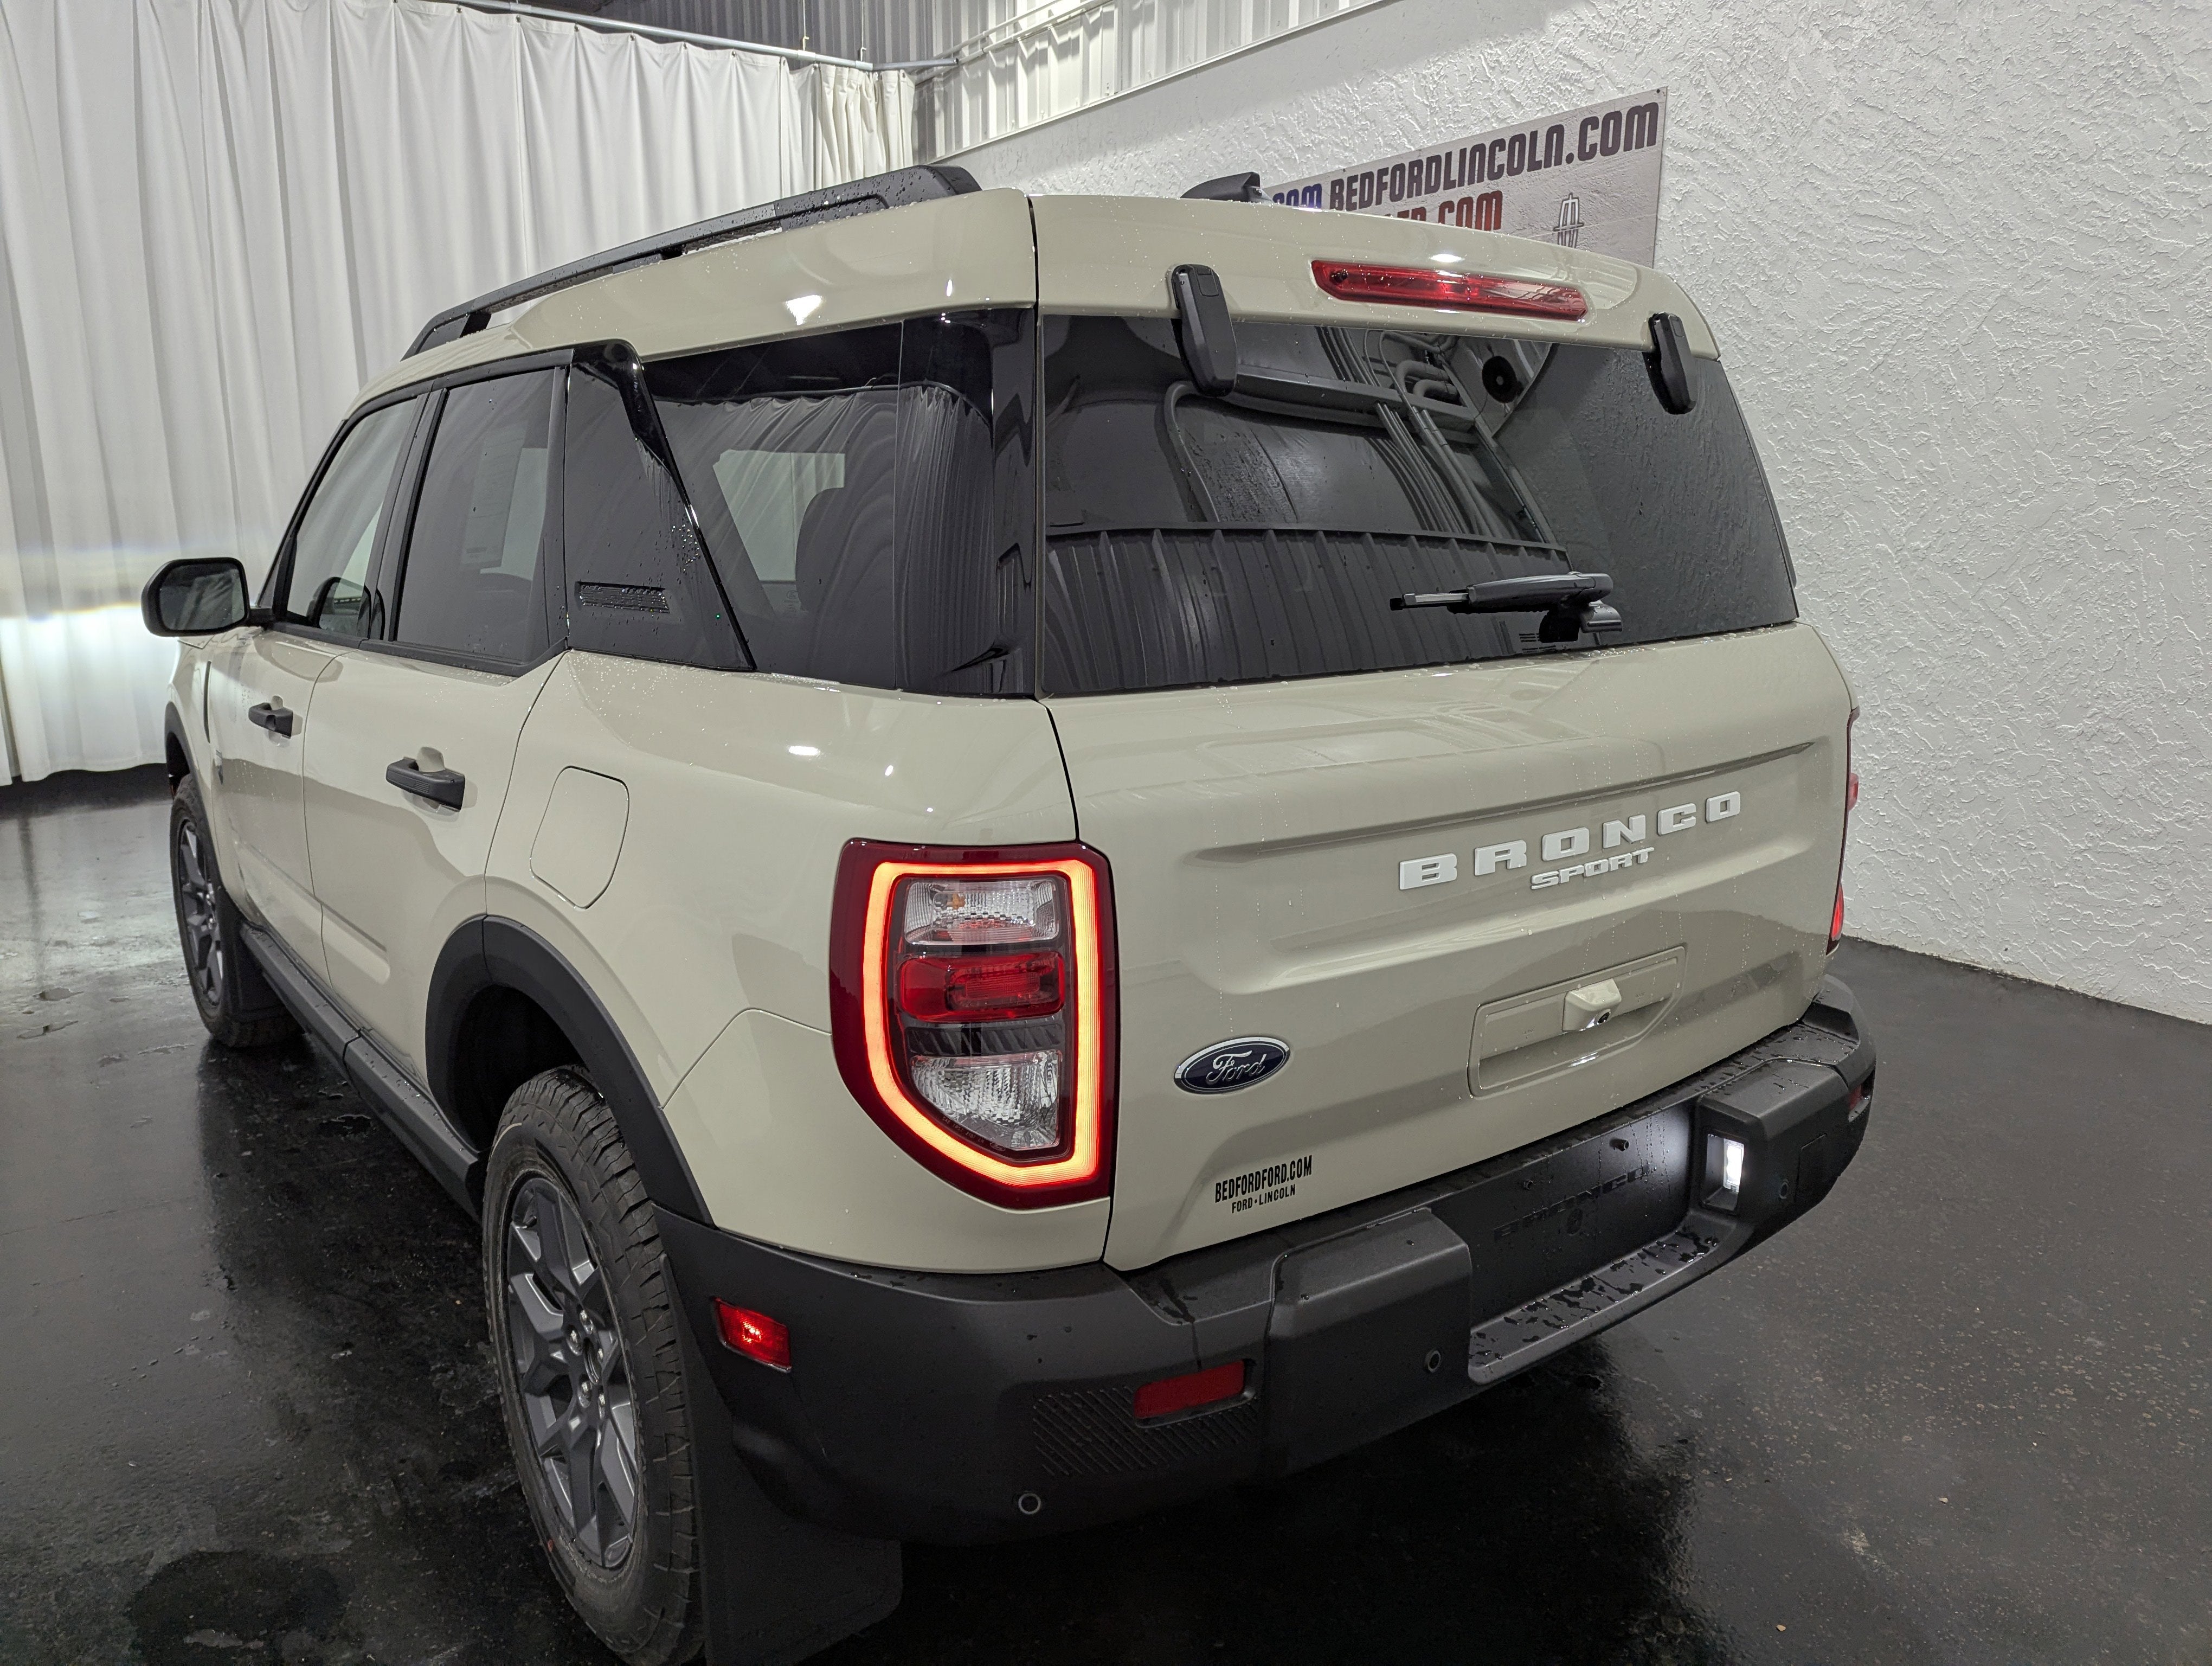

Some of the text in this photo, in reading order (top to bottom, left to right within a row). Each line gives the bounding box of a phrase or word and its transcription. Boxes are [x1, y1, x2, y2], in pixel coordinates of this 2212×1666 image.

[1330, 102, 1659, 212] BEDFORDLINCOLN.COM
[1399, 791, 1741, 890] BRONCO
[1531, 847, 1655, 890] SPORT
[1205, 1050, 1267, 1085] Ford
[1215, 1155, 1313, 1203] BEDFORDFORD.COM
